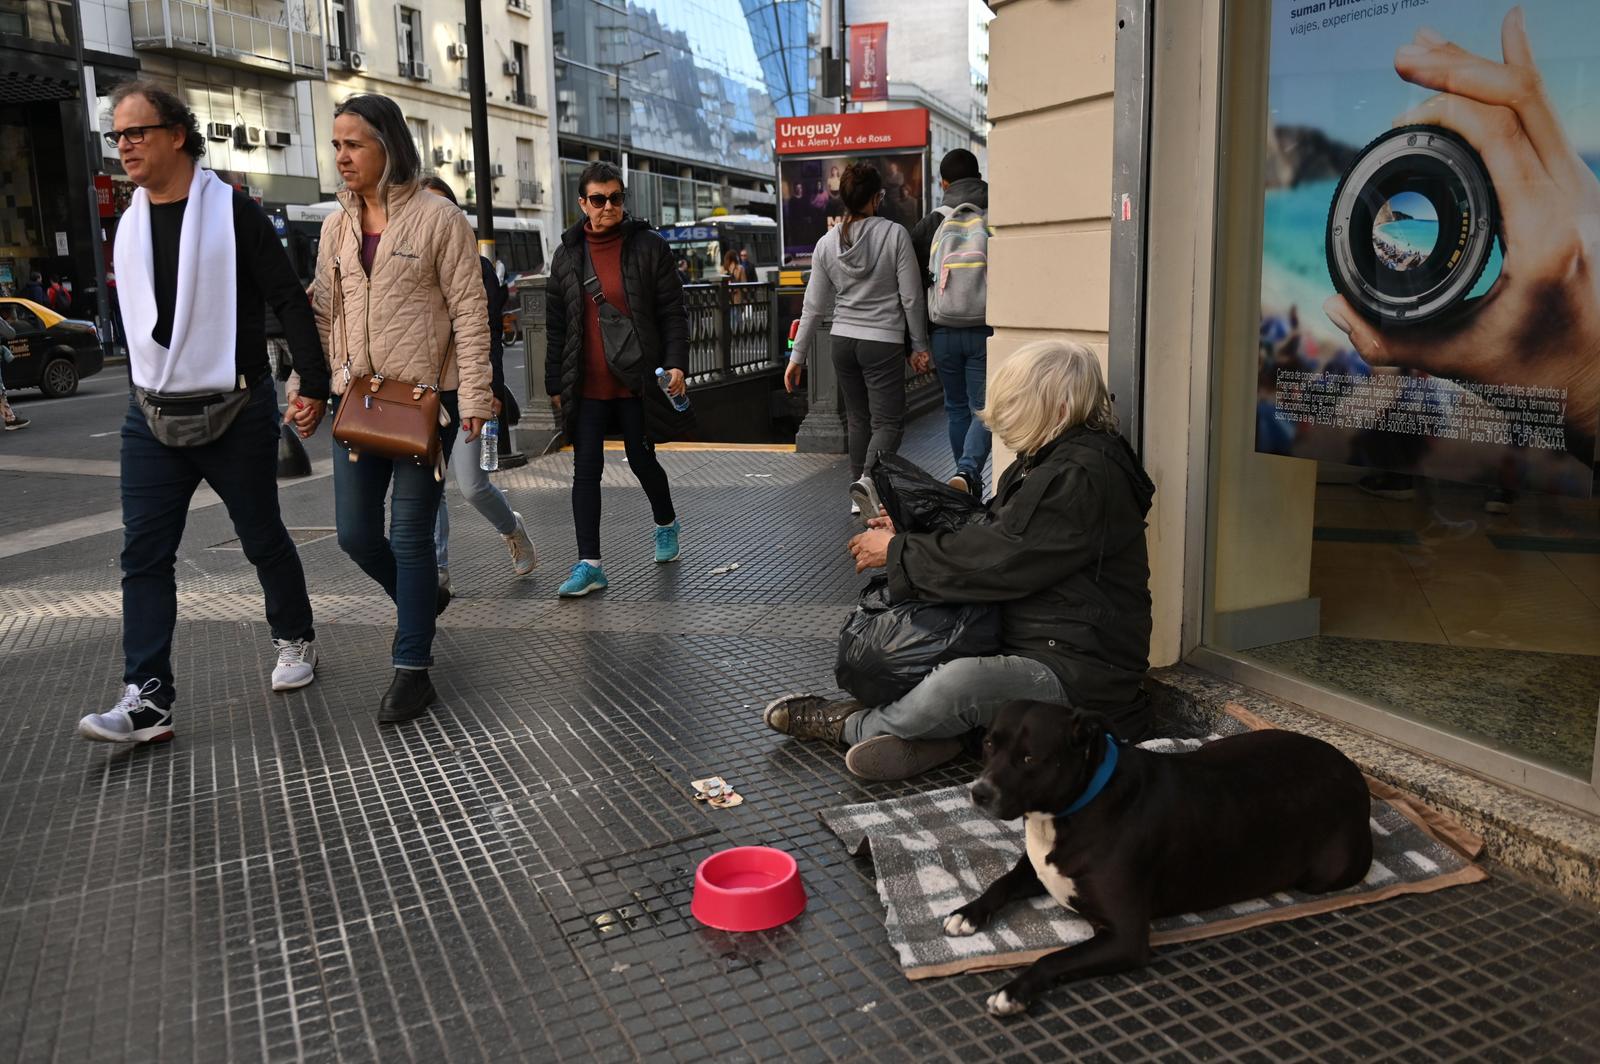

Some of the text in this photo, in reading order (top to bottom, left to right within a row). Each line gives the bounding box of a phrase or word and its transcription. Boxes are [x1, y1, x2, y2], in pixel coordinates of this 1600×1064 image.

[1290, 21, 1320, 35] viajes,
[1322, 4, 1389, 28] experiencias
[1391, 1, 1398, 15] y
[1291, 2, 1325, 19] suman
[780, 123, 842, 138] Uruguay
[788, 140, 795, 148] L.
[797, 139, 806, 147] N.
[808, 138, 829, 147] Alem
[844, 136, 855, 145] M.
[856, 135, 867, 144] de
[868, 134, 892, 143] Rosas
[667, 227, 706, 241] 146
[1307, 381, 1325, 392] Puntos
[1326, 382, 1341, 393] BBVA
[1341, 385, 1352, 396] que
[1395, 388, 1403, 398] de
[1517, 396, 1527, 409] los
[1484, 383, 1499, 395] para
[1499, 383, 1525, 396] clientes
[1526, 384, 1560, 398] adheridos
[1561, 387, 1568, 400] al
[1512, 421, 1521, 433] de
[1522, 422, 1533, 435] las
